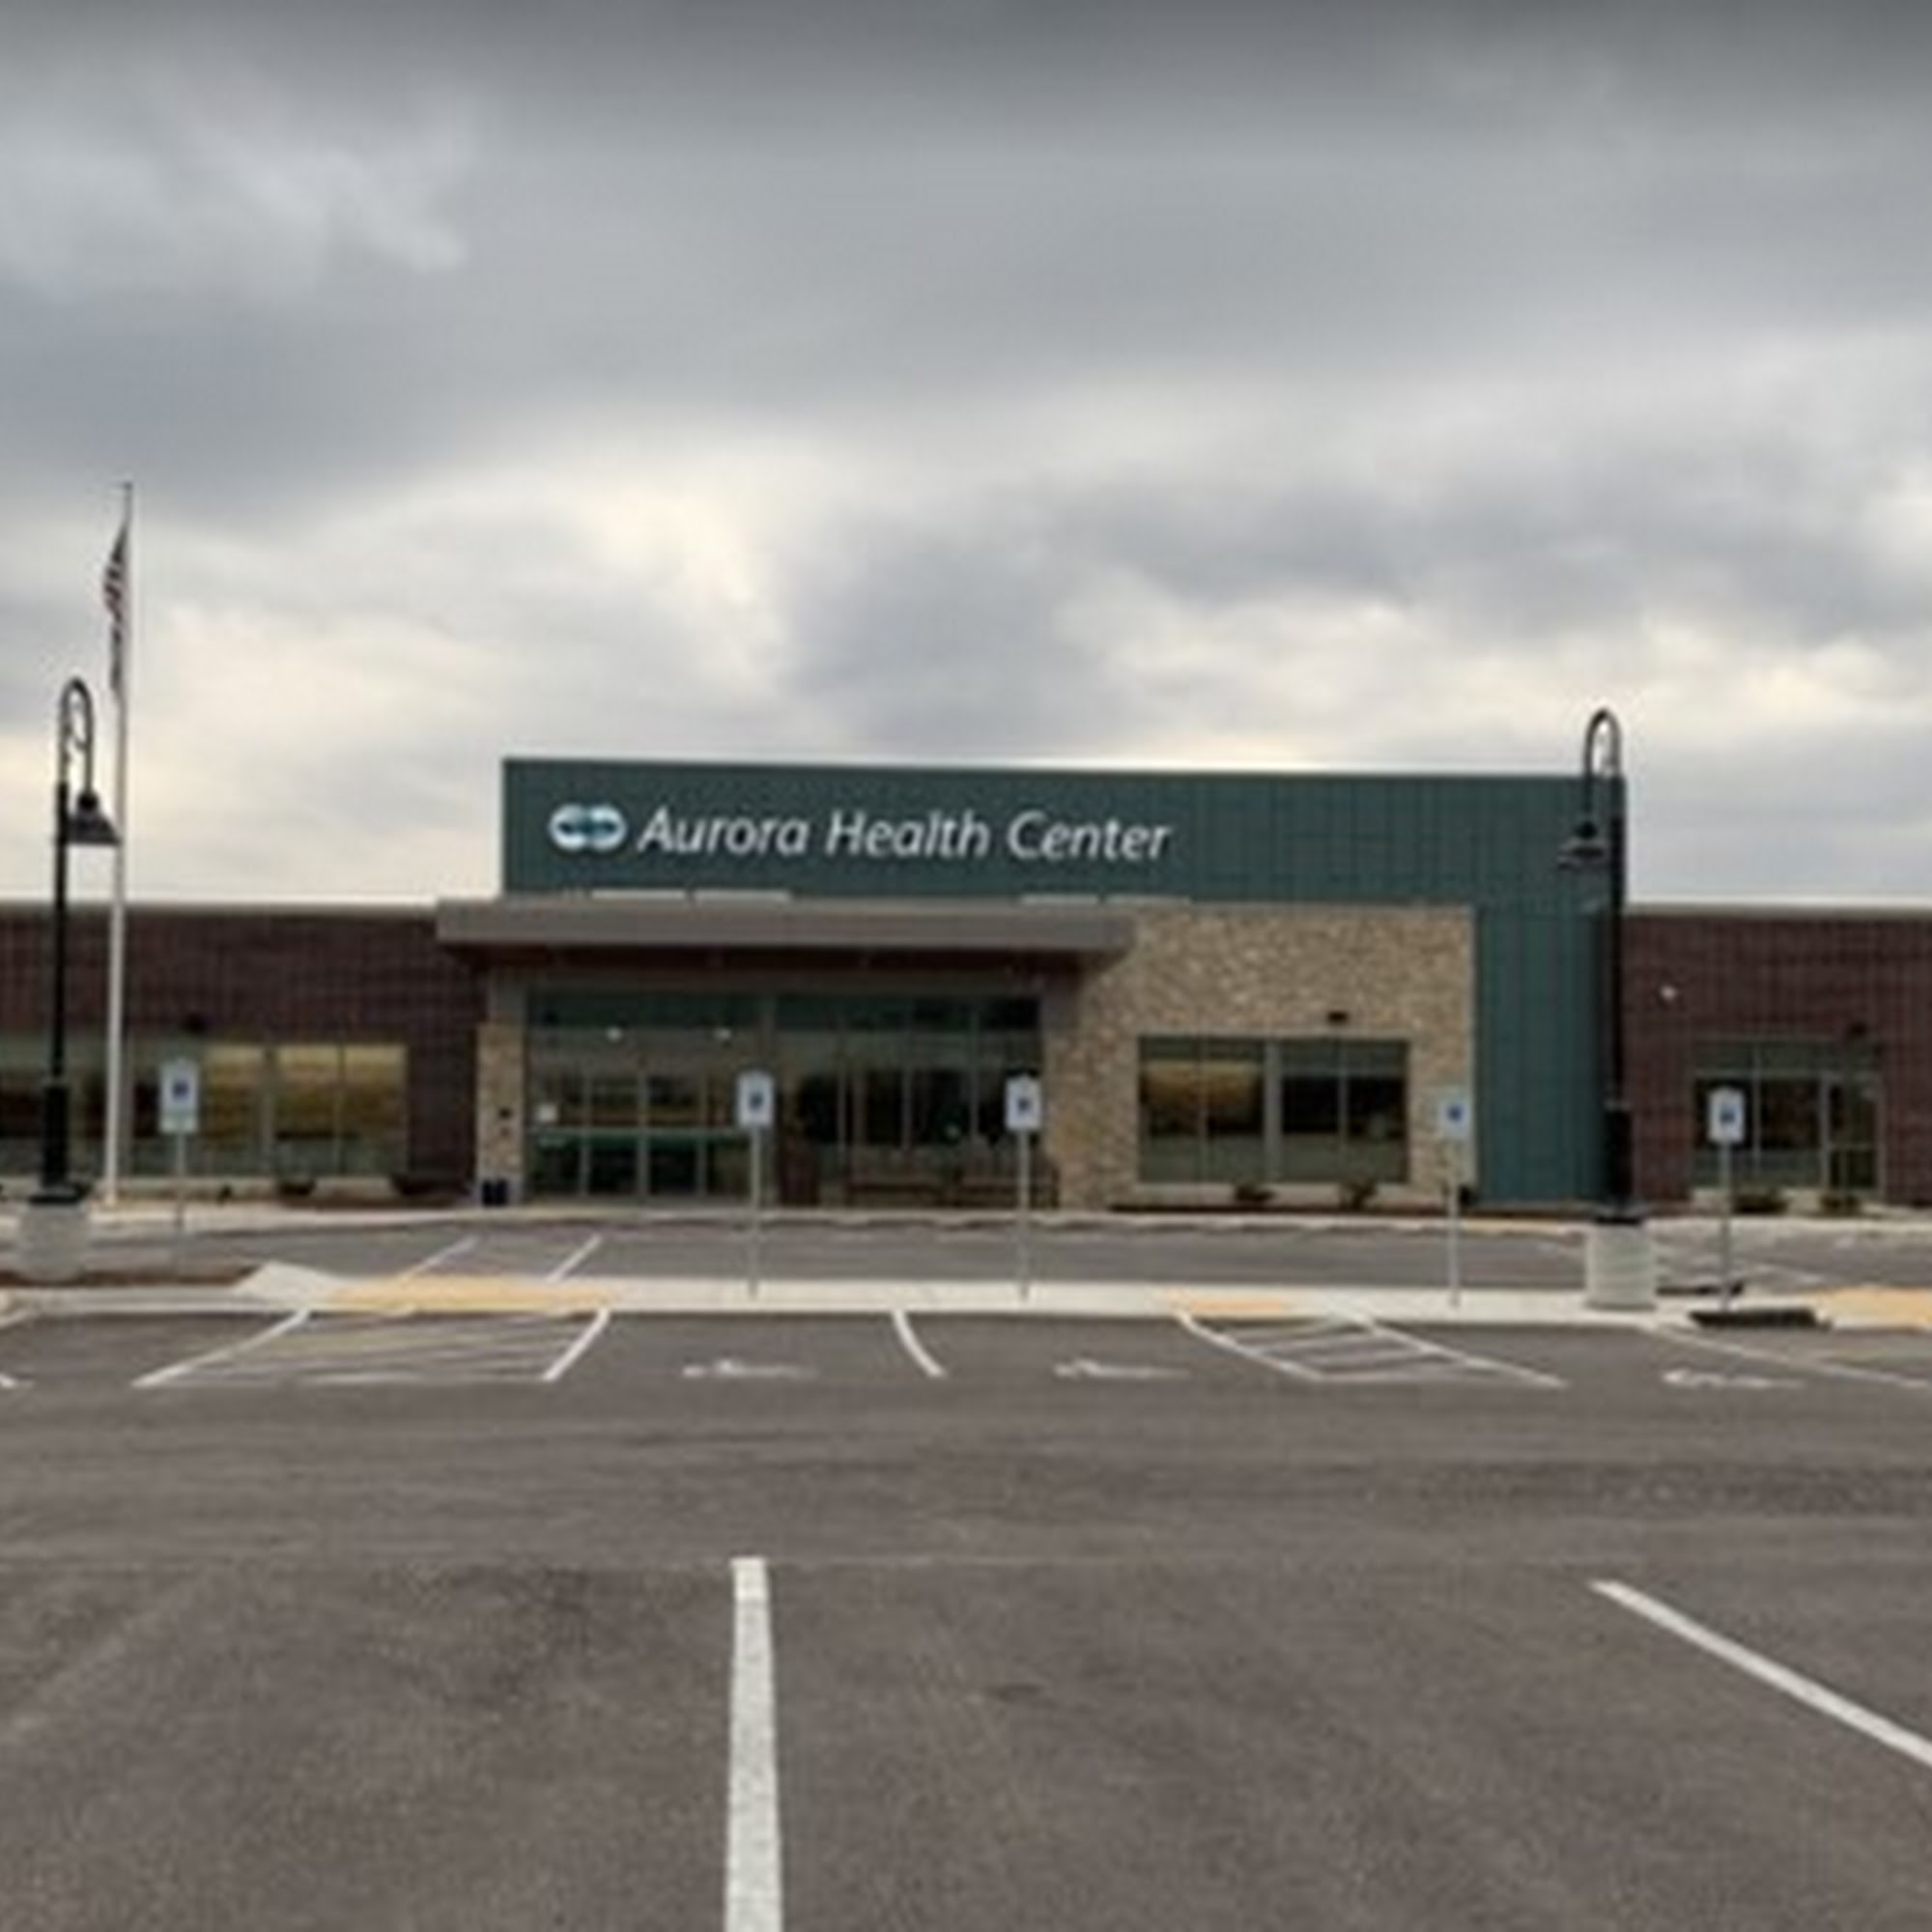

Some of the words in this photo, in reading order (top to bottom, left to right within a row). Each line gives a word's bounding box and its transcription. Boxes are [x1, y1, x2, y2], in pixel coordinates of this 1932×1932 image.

[637, 806, 810, 856] Aurora
[826, 809, 990, 858] Health
[1007, 810, 1172, 861] Center
